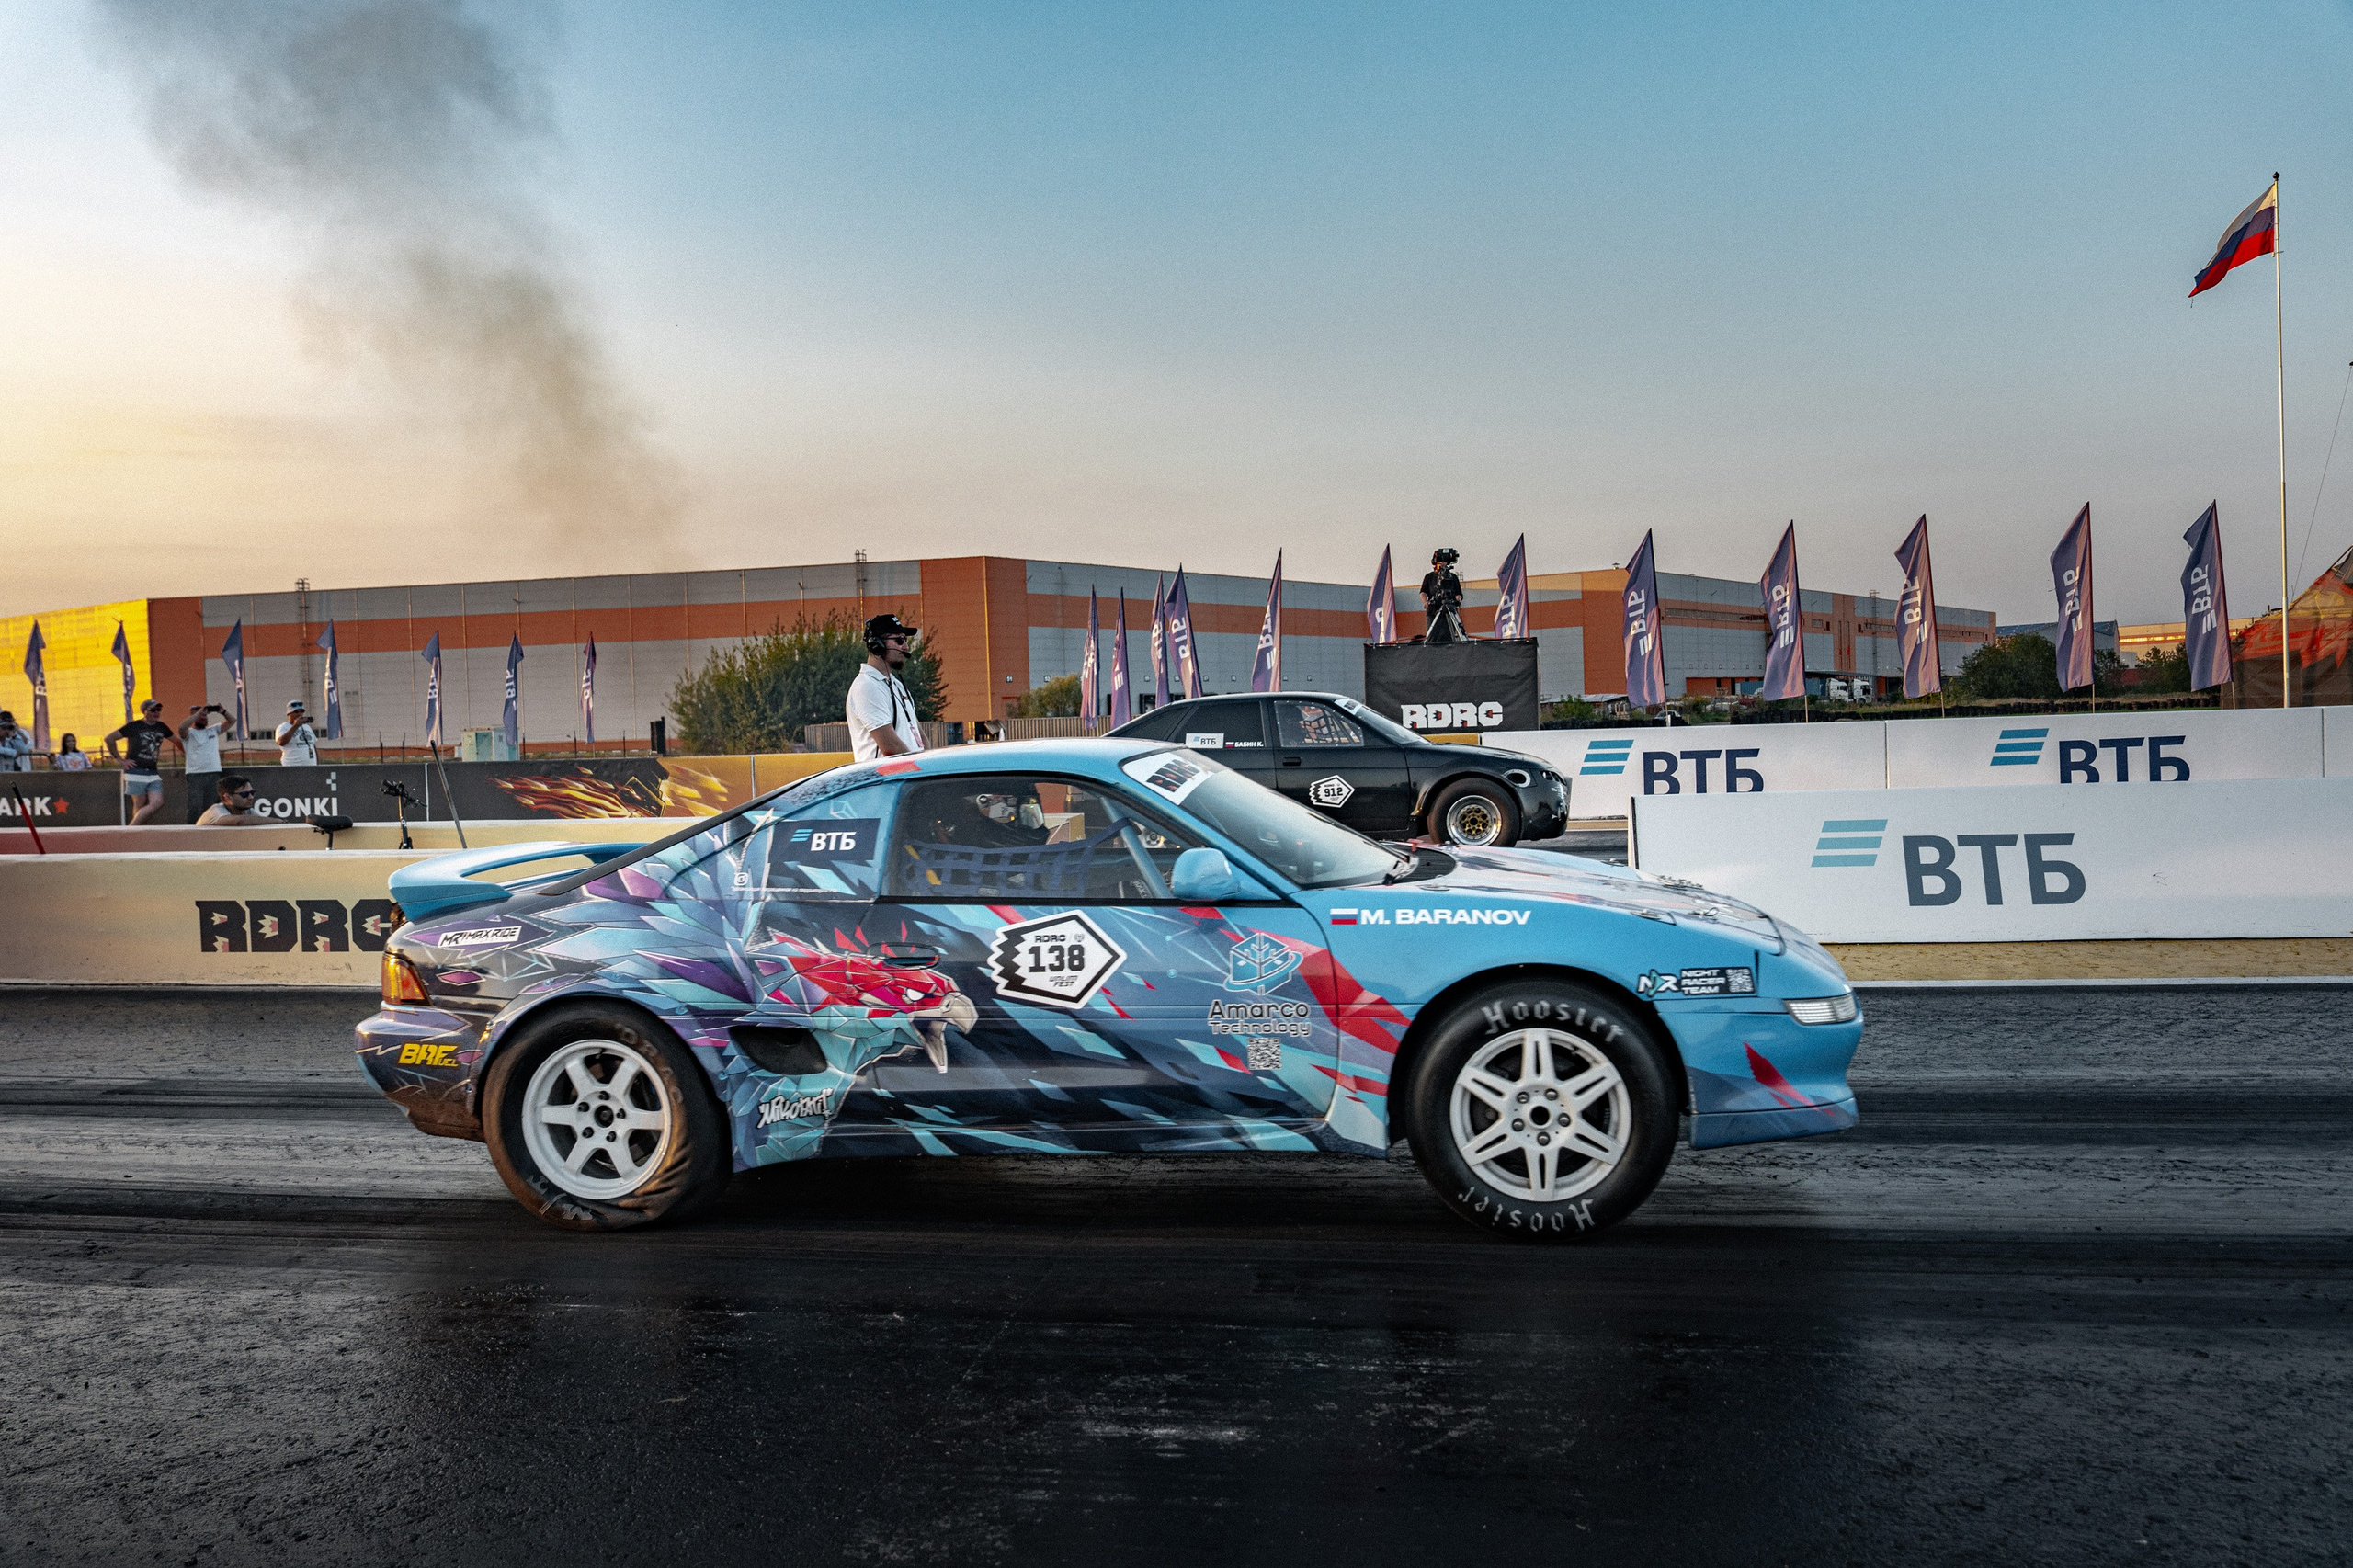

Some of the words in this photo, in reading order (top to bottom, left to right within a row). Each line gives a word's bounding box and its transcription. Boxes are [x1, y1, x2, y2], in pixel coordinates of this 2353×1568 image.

[1400, 701, 1504, 729] RDRC
[1200, 737, 1217, 745] ВТБ
[2058, 735, 2190, 784] ВТБ
[1643, 748, 1765, 796] ВТБ
[1324, 787, 1344, 798] 912
[254, 797, 338, 817] GONKI
[810, 831, 857, 851] ВТБ
[1902, 833, 2086, 907] ВТБ
[195, 899, 395, 952] RDRC
[1360, 908, 1392, 925] M.
[1395, 908, 1532, 925] BARANOV
[1034, 934, 1066, 943] RDRC
[1029, 944, 1085, 972] 138
[1680, 977, 1726, 986] RACER
[1681, 969, 1721, 978] NIGHT
[1680, 986, 1720, 994] TEAM
[1208, 999, 1311, 1019] Amarco
[1208, 1019, 1312, 1037] Technology
[1480, 1000, 1624, 1043] Hoosier
